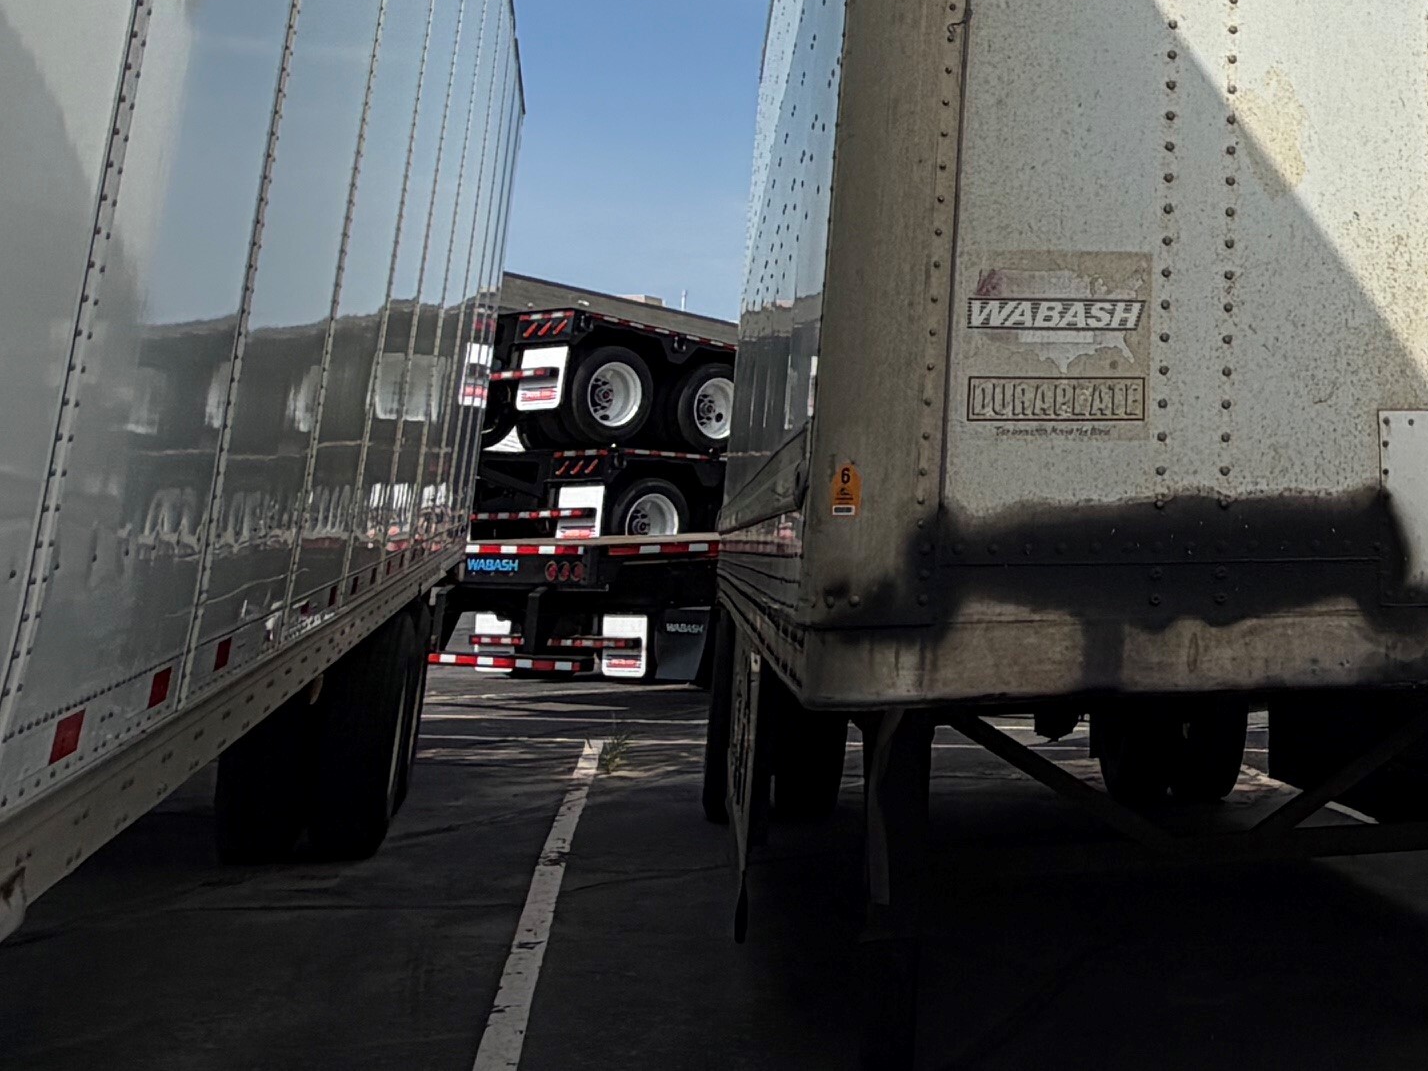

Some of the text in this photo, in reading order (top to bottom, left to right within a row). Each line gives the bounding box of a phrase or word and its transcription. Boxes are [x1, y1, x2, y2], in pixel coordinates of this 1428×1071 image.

[970, 300, 1143, 328] WABASH
[971, 382, 1141, 417] DURAPLATE
[841, 467, 851, 484] 6
[467, 558, 519, 571] WABASH
